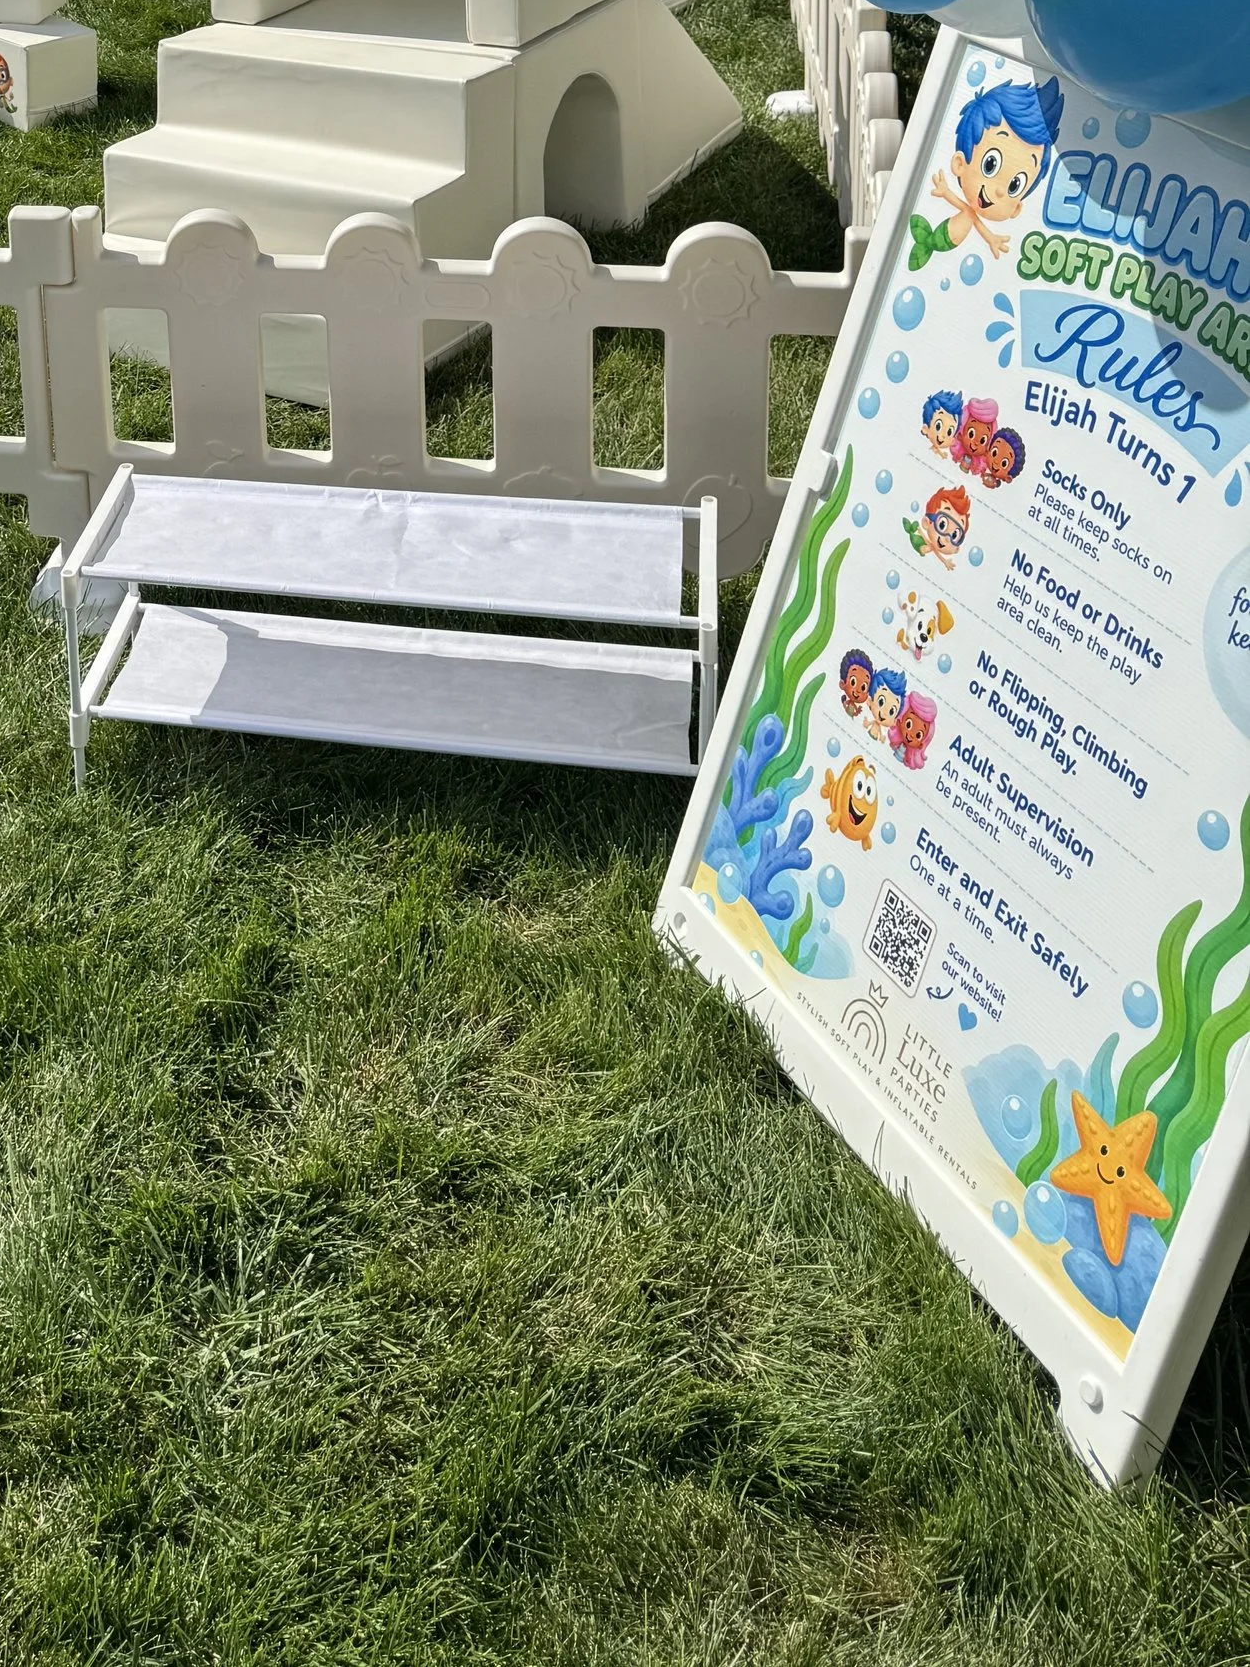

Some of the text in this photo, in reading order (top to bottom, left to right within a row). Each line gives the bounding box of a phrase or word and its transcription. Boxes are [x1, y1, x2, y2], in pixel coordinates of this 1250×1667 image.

[1017, 231, 1250, 383] SOFT PLAY AR
[1034, 304, 1221, 451] Rules
[1025, 380, 1197, 503] Elijah Turns 1
[1028, 505, 1100, 562] at all times.
[1034, 483, 1173, 584] Please keep socks on
[1042, 459, 1131, 531] Socks Only
[997, 596, 1063, 653] area clean.
[1003, 574, 1142, 686] Help us keep the play
[1011, 548, 1164, 669] No Food or Drinks
[1228, 587, 1250, 616] fo
[1228, 620, 1250, 649] ke
[969, 680, 1077, 776] or Rough Play.
[976, 649, 1149, 799] No Flipping, Climbing
[935, 776, 1001, 844] be present.
[941, 760, 1073, 880] An adult must always
[949, 734, 1094, 867] Adult Supervision
[910, 854, 995, 944] One at a time.
[915, 827, 1089, 999] Enter and Exit Safely
[941, 960, 1003, 1023] our website!
[946, 942, 1007, 1006] Scan to visit
[796, 992, 829, 1029] STYLISH
[831, 1028, 851, 1052] SOFT
[852, 1052, 874, 1076] PLAY
[883, 1087, 935, 1145] INFLATABLE
[937, 1145, 978, 1190] RENTALS
[890, 1066, 938, 1123] PARTIES
[896, 1038, 947, 1104] Luxe
[904, 1023, 953, 1079] LITTLE
